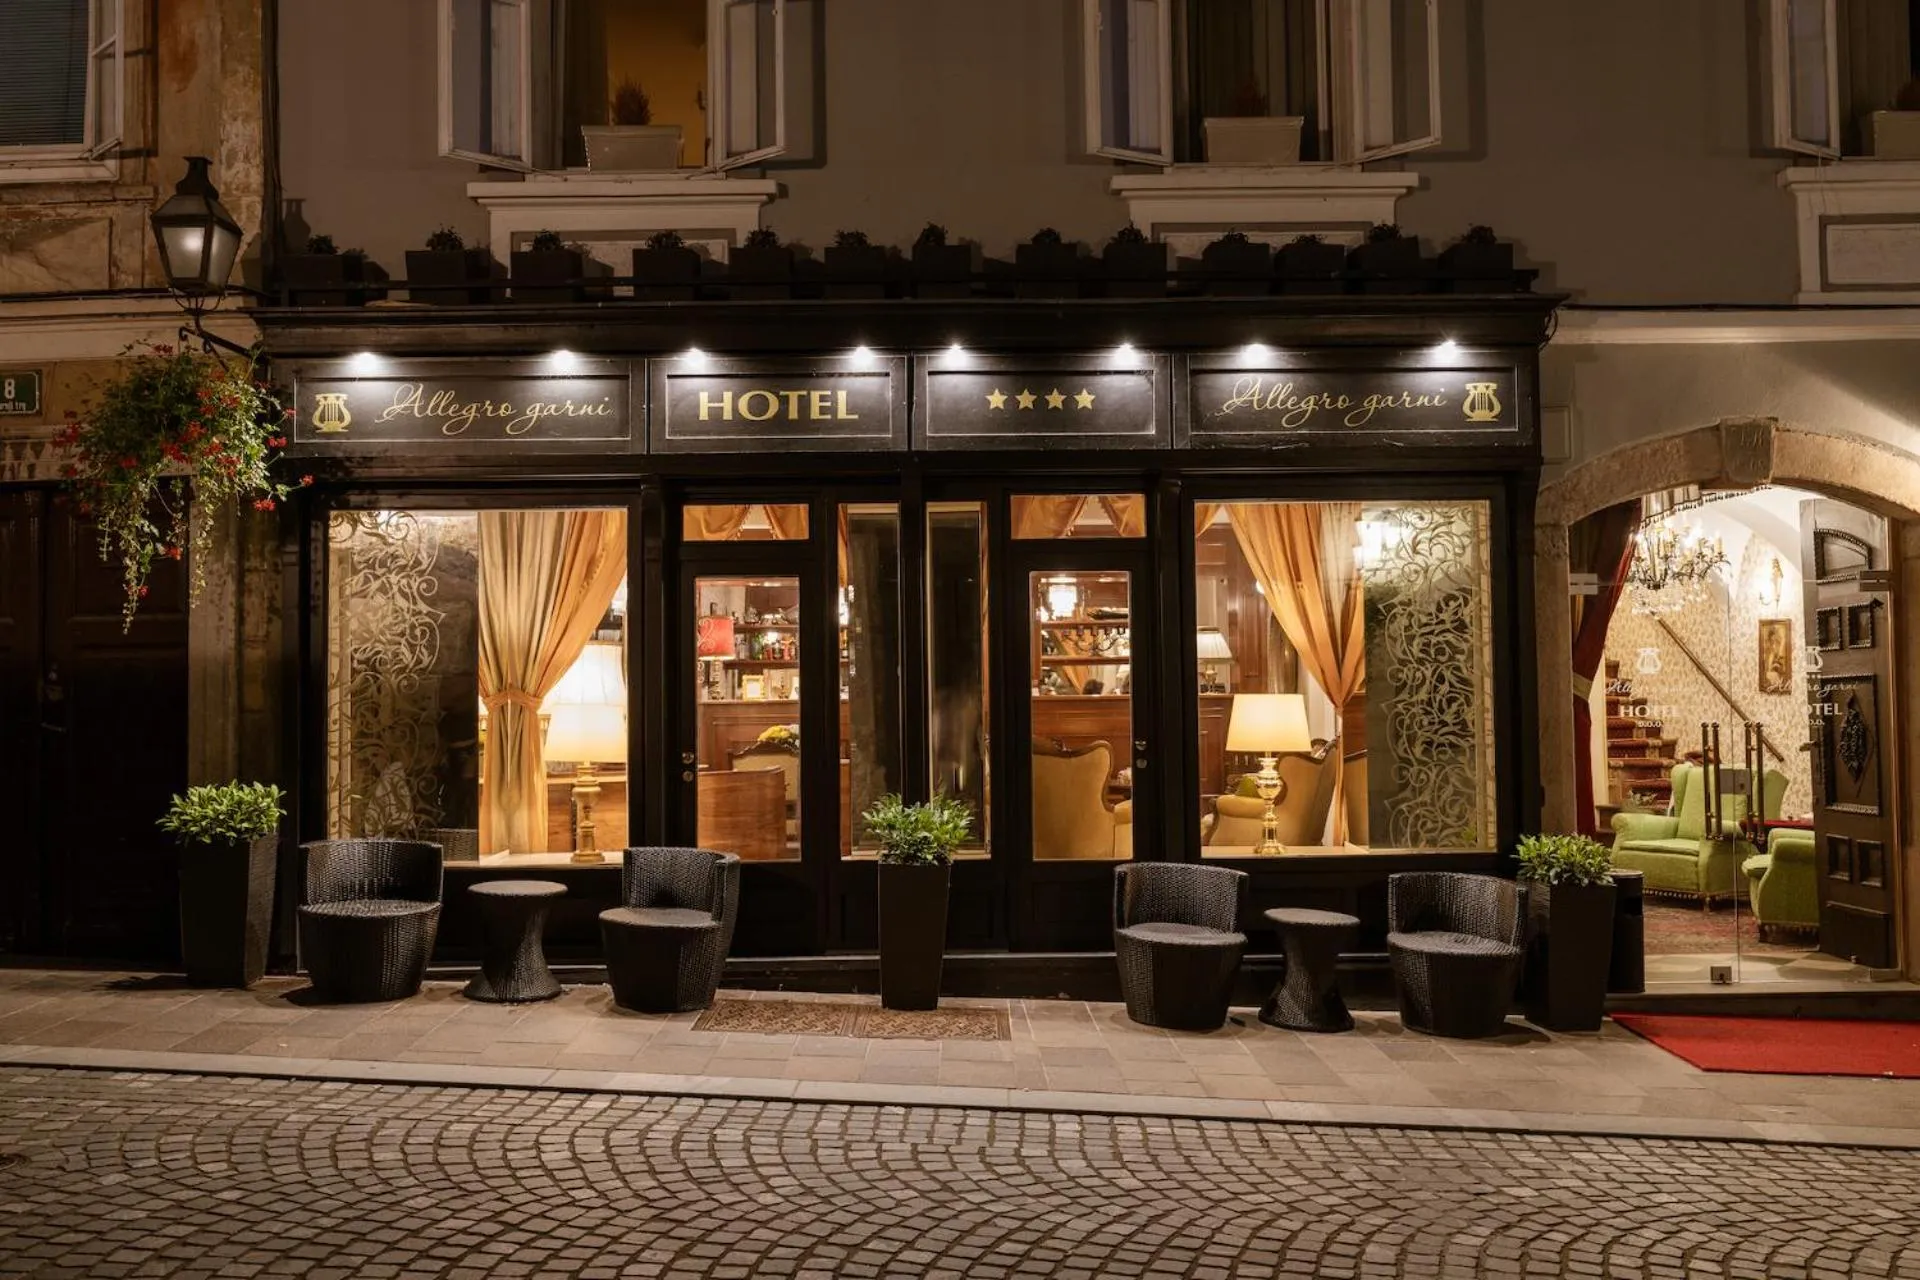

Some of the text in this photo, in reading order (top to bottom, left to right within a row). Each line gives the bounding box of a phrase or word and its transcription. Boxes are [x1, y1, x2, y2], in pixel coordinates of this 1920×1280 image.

[4, 378, 15, 400] 8
[374, 382, 612, 435] Allegro garni
[698, 389, 859, 421] HOTEL
[1214, 376, 1447, 428] Allegro garni
